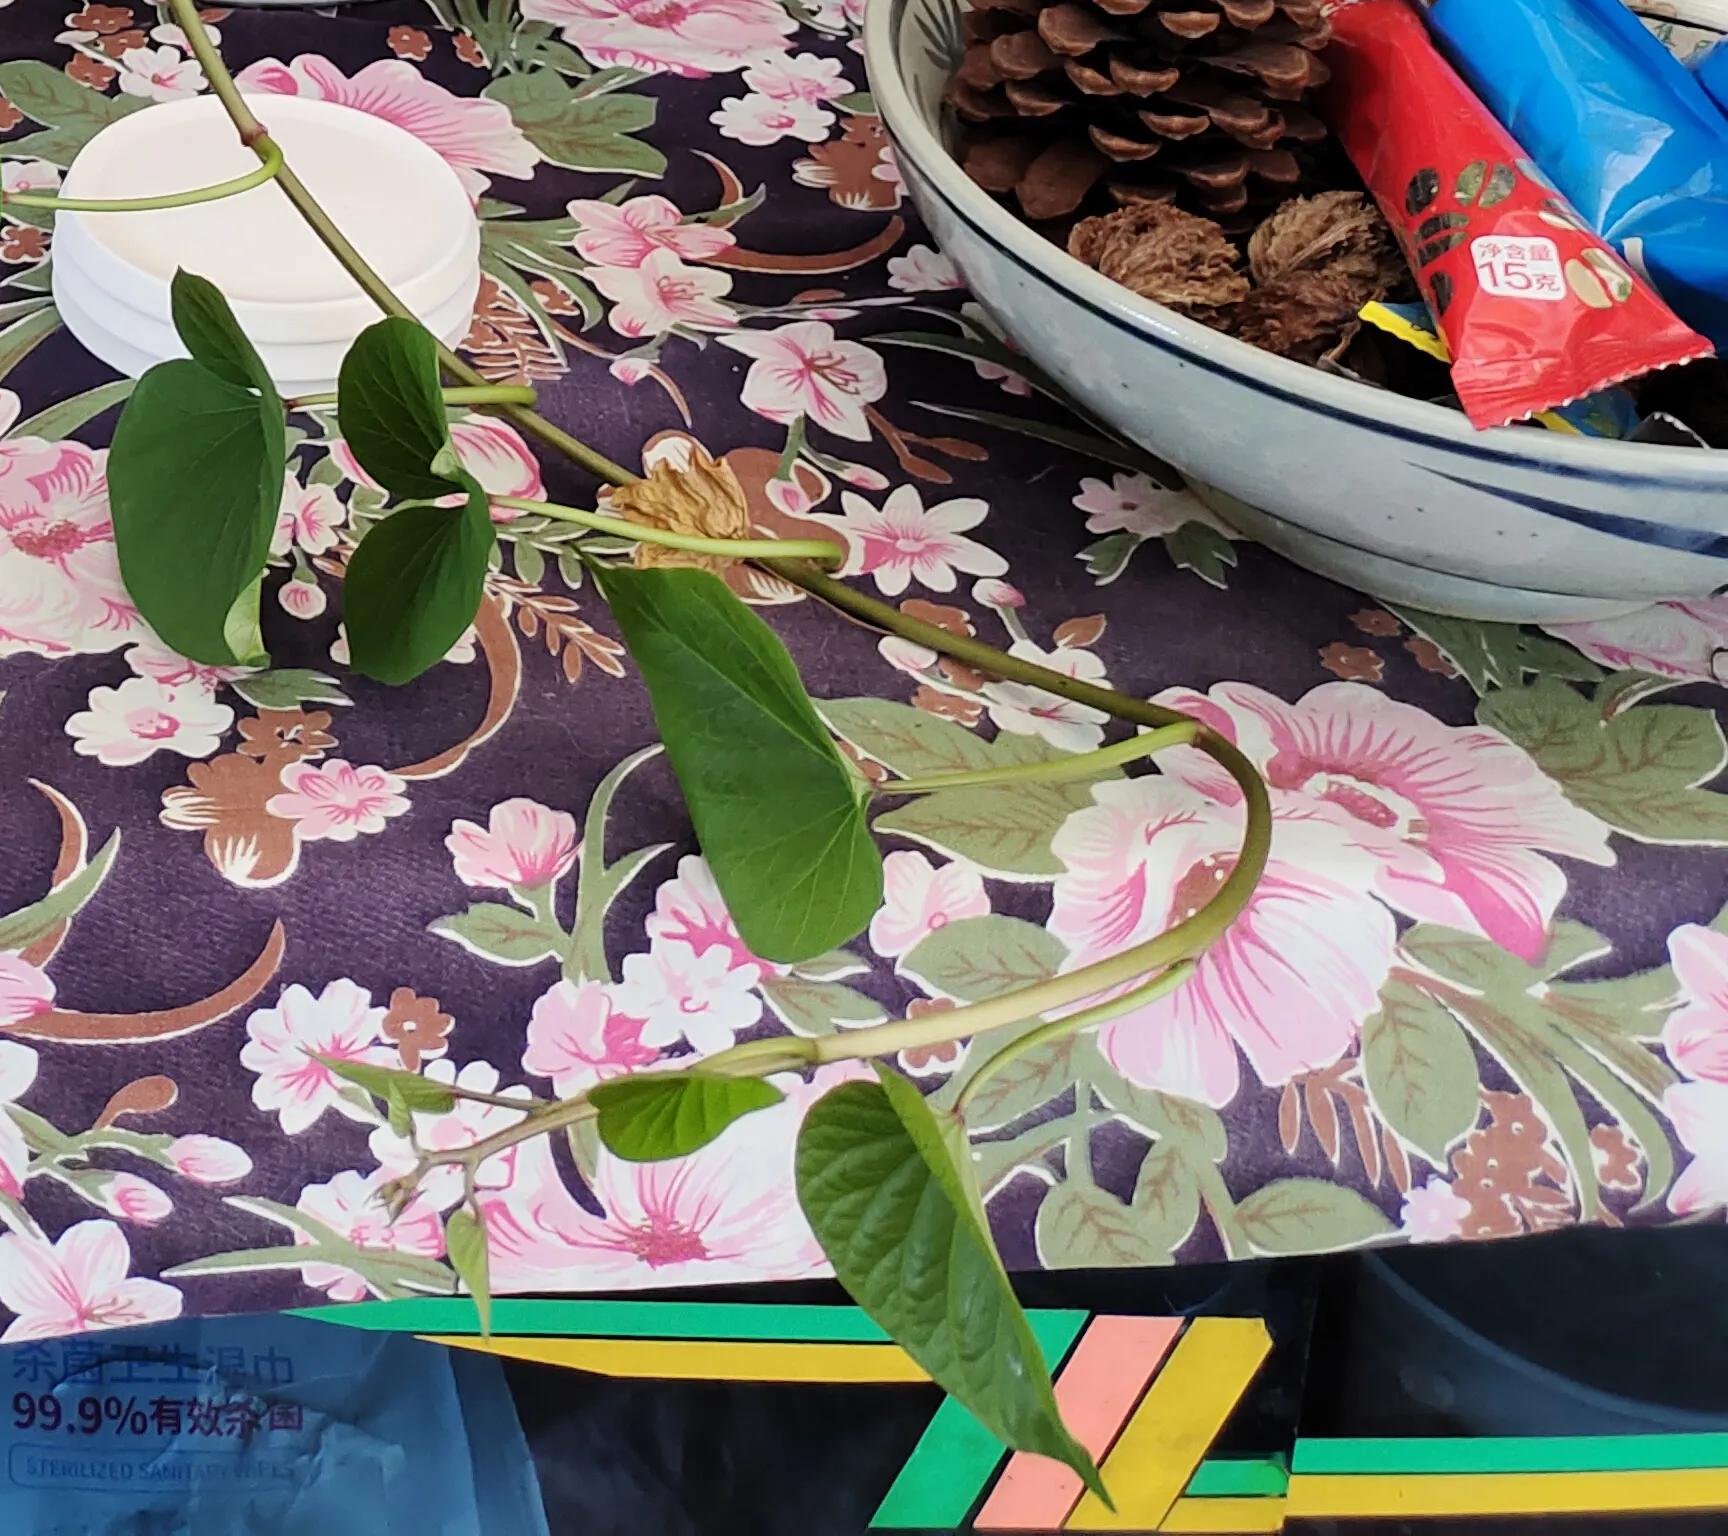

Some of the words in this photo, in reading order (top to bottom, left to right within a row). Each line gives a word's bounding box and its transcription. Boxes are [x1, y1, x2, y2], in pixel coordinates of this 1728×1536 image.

[1477, 242, 1553, 262] 净含量
[1478, 261, 1561, 291] 15克
